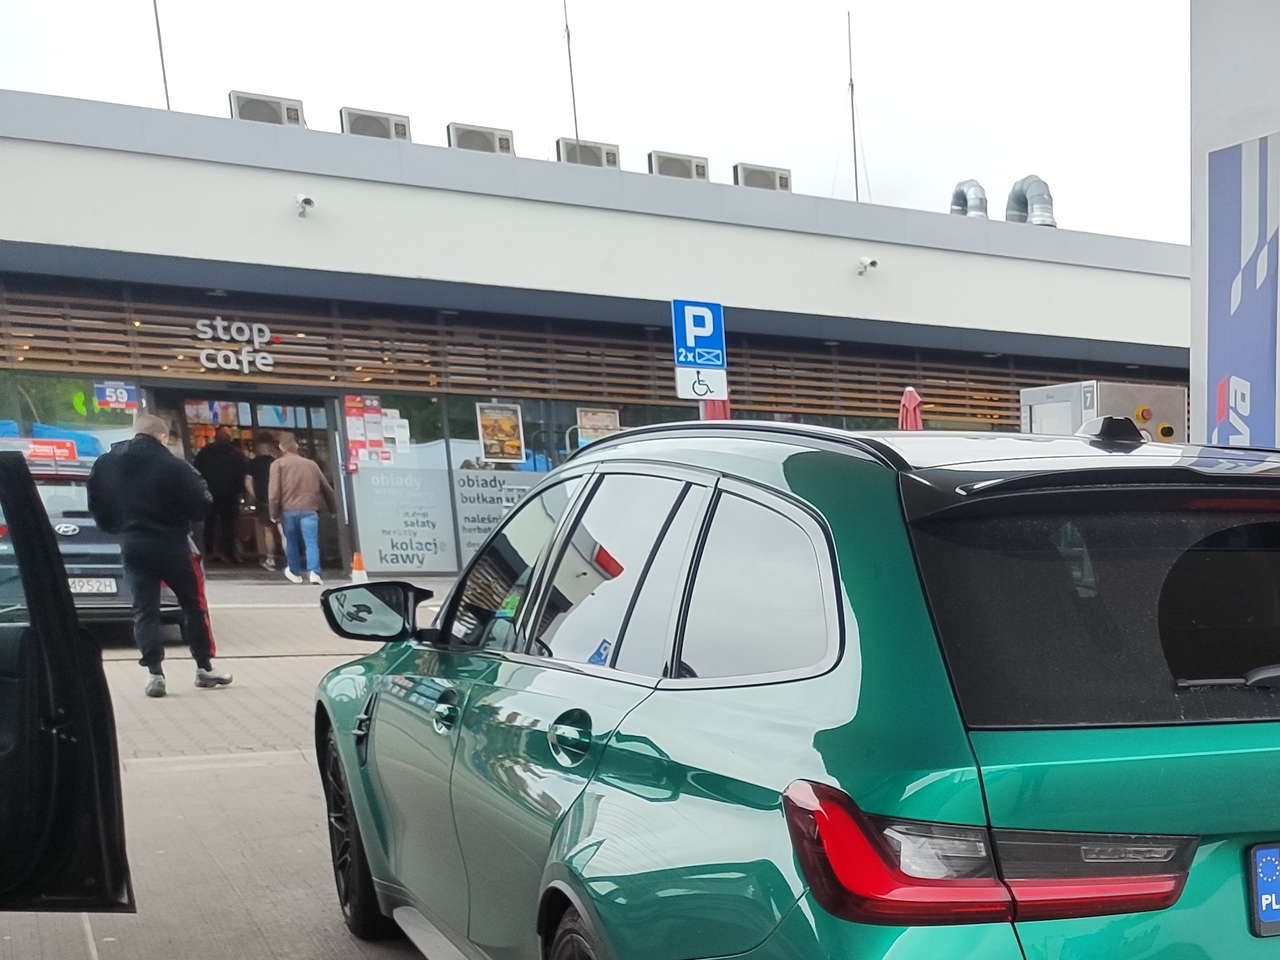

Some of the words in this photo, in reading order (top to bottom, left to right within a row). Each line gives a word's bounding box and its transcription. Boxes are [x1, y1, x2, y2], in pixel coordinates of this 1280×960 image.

[684, 305, 714, 348] P
[200, 347, 275, 374] cafe
[105, 388, 128, 403] 59
[1085, 393, 1092, 407] 7
[371, 473, 422, 490] obiady
[458, 475, 506, 492] obiady
[462, 525, 492, 534] herbat
[379, 549, 426, 569] kawy
[1261, 894, 1280, 911] PL
